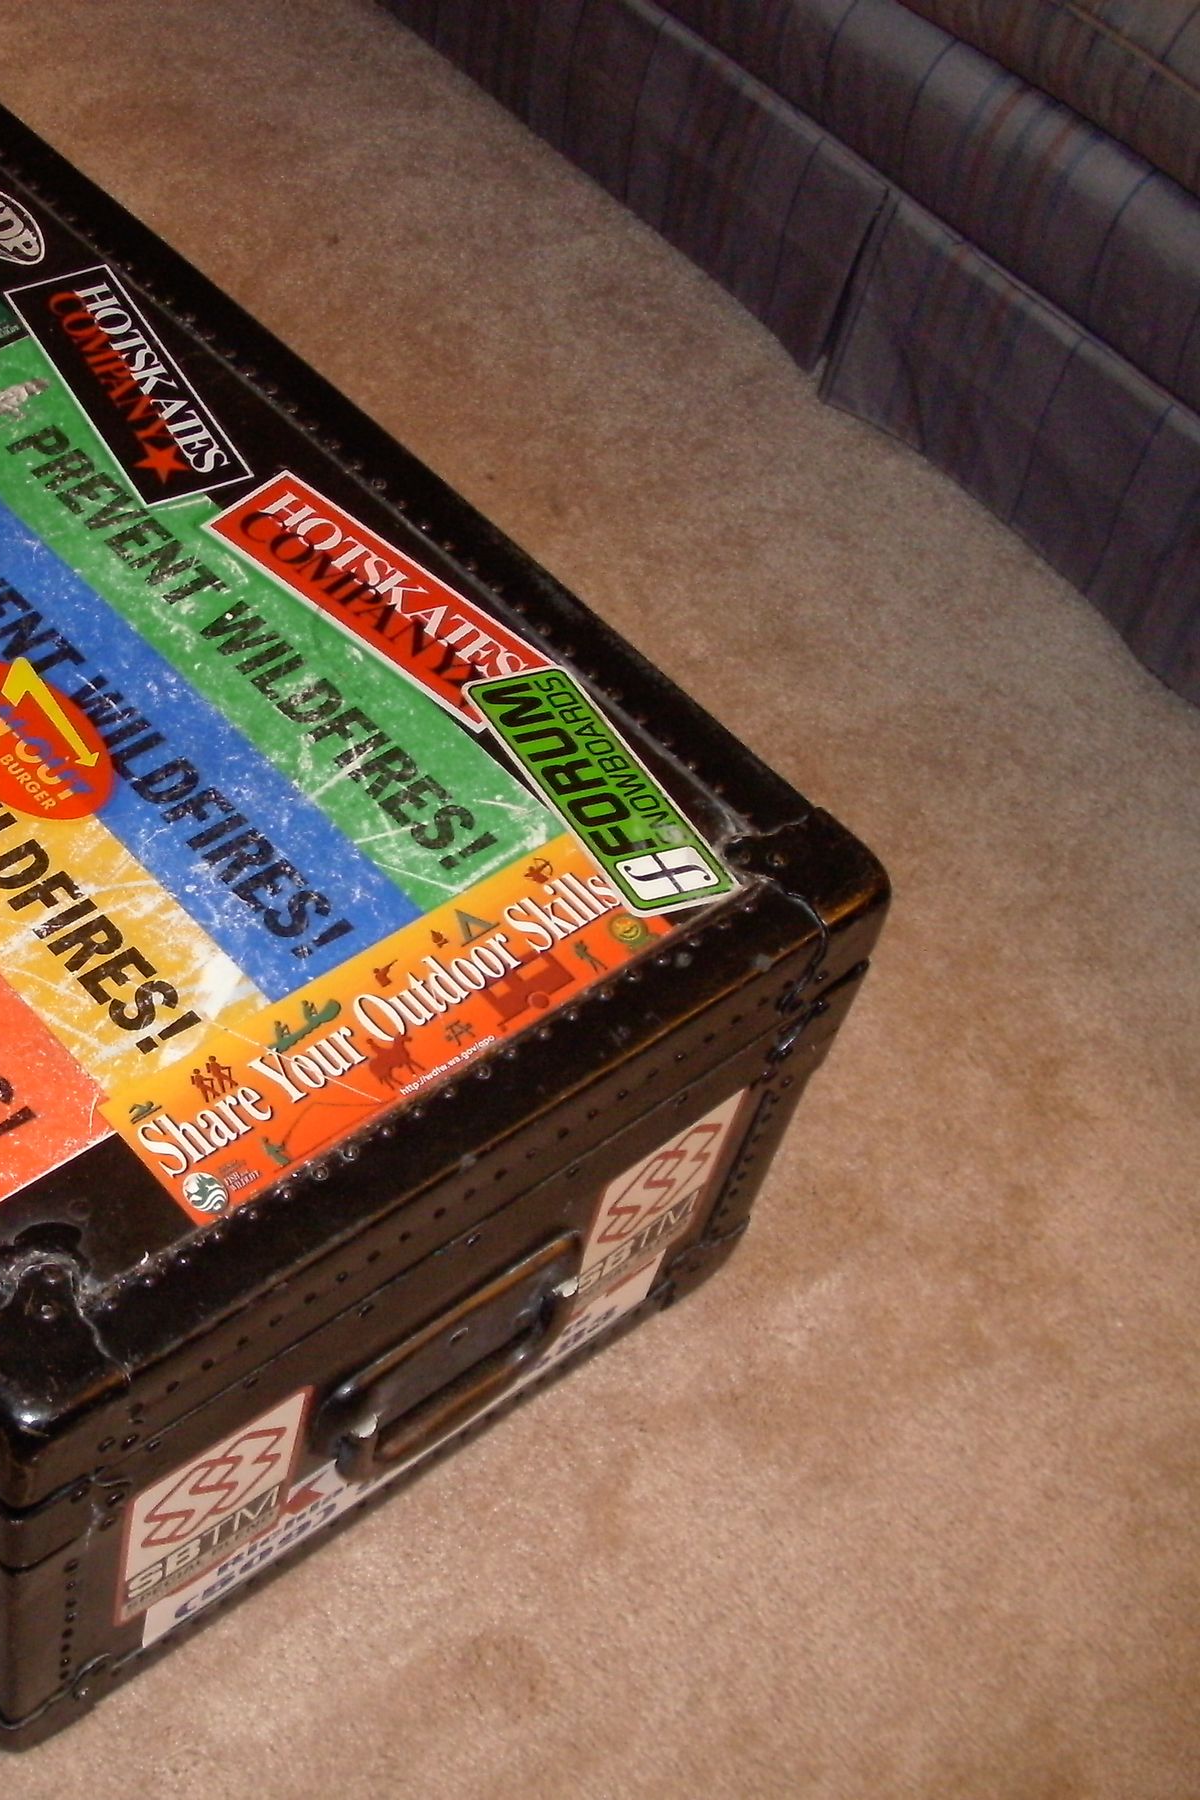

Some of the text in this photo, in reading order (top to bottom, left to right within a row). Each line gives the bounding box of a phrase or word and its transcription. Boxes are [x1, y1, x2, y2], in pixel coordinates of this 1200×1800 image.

[50, 291, 180, 445] COMPANY
[73, 282, 230, 473] HOTSKATES
[6, 426, 498, 870] PREVENT WILDFIRES!
[259, 491, 528, 677] HOTSKATES
[0, 754, 57, 810] BURGER
[70, 673, 355, 959] WILDFIRES!
[481, 682, 659, 857] FORUM
[136, 870, 622, 1180] Share Your Outdoor Skills
[578, 1190, 699, 1294] SBTM
[128, 1485, 279, 1598] SBTM
